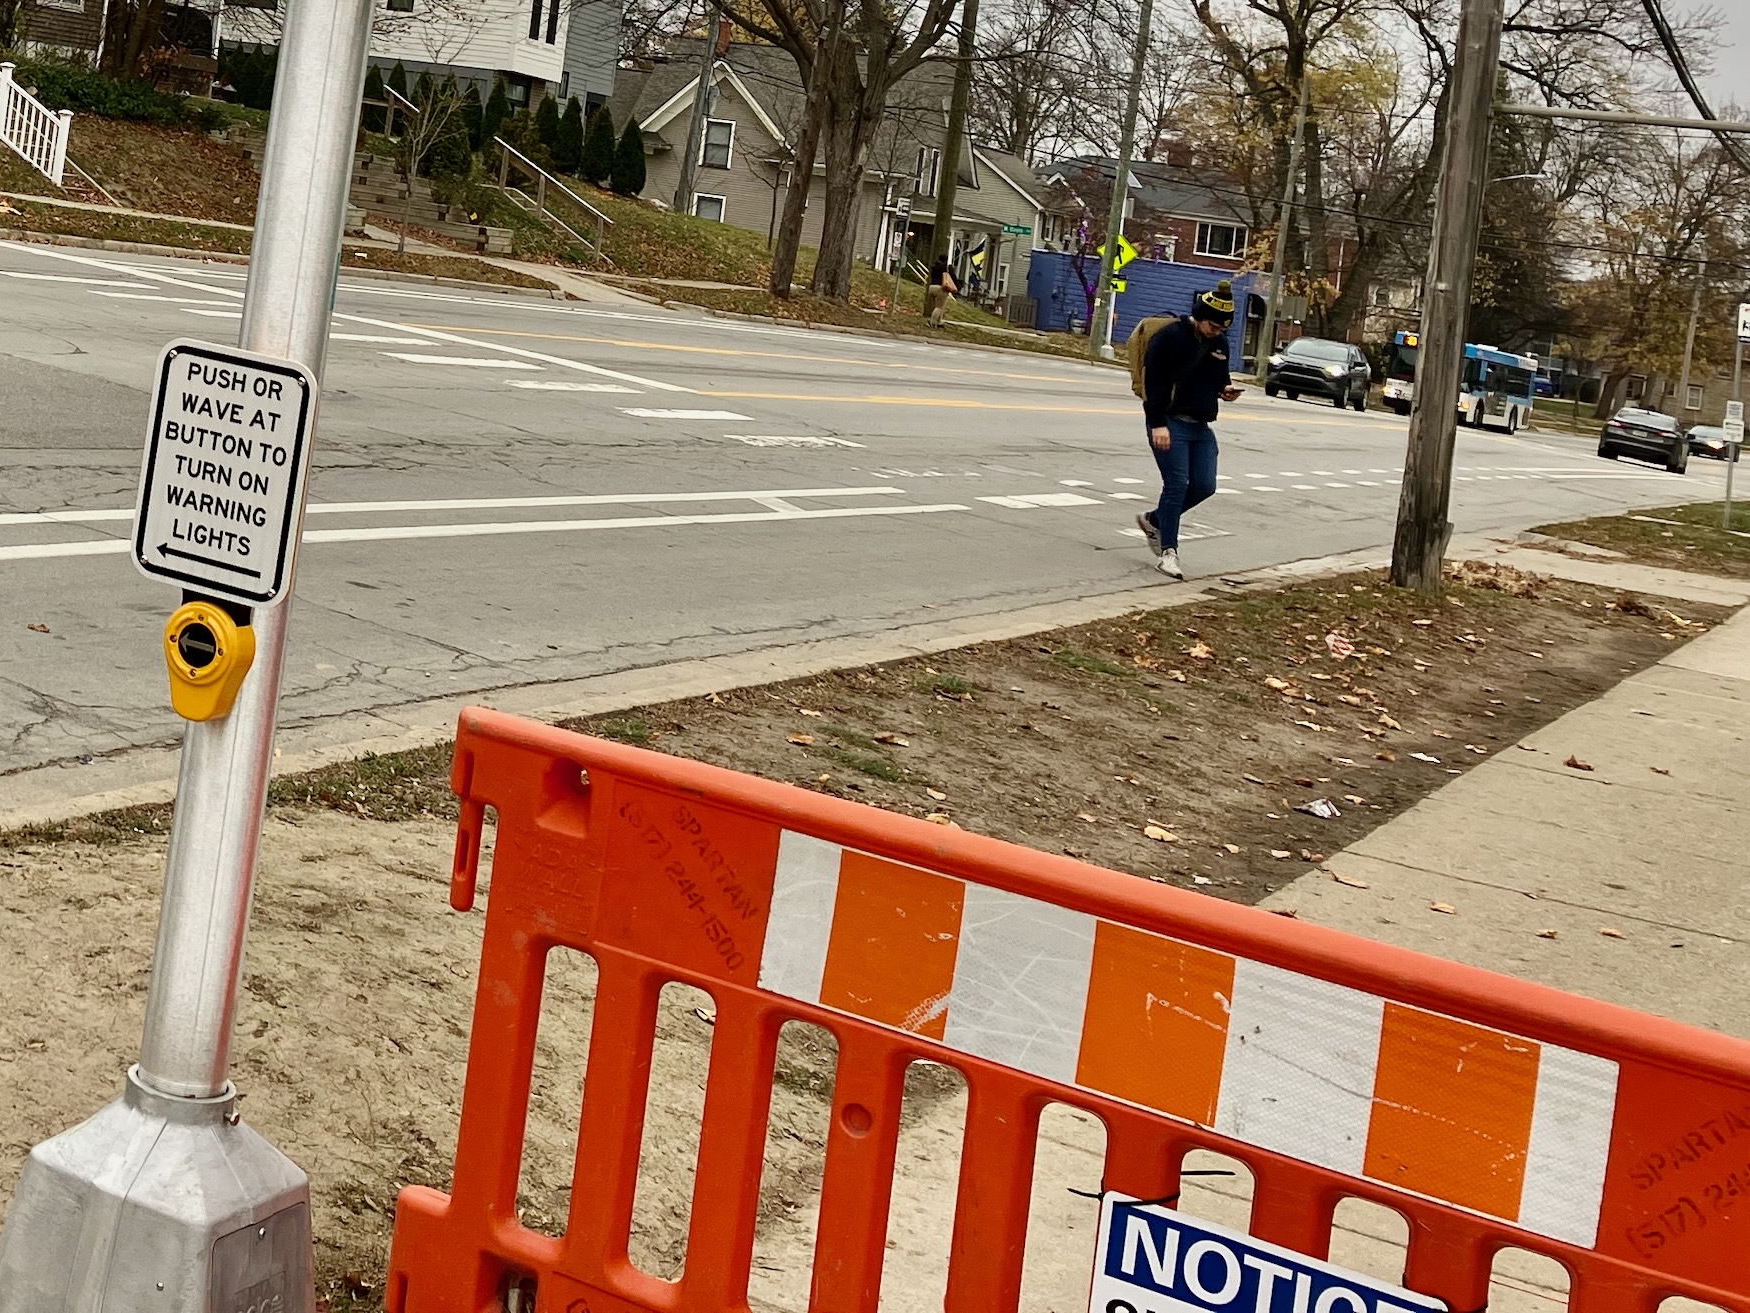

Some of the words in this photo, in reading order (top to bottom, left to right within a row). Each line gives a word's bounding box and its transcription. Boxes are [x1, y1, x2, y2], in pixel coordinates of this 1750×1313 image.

[187, 362, 246, 393] PUSH
[253, 377, 283, 401] OR
[181, 392, 244, 425] WAVE
[249, 409, 281, 433] AT
[165, 421, 252, 459] BUTTON
[259, 443, 287, 466] TO
[175, 455, 232, 487] TURN
[238, 471, 269, 496] ON
[166, 485, 267, 527] WARNING
[172, 519, 251, 556] LIGHTS
[672, 805, 758, 922] SPARTAN
[665, 860, 746, 972] 244-1500
[1628, 1106, 1750, 1191] SPARTA
[1625, 1196, 1708, 1259] (517)
[1120, 1214, 1417, 1313] NOTI
